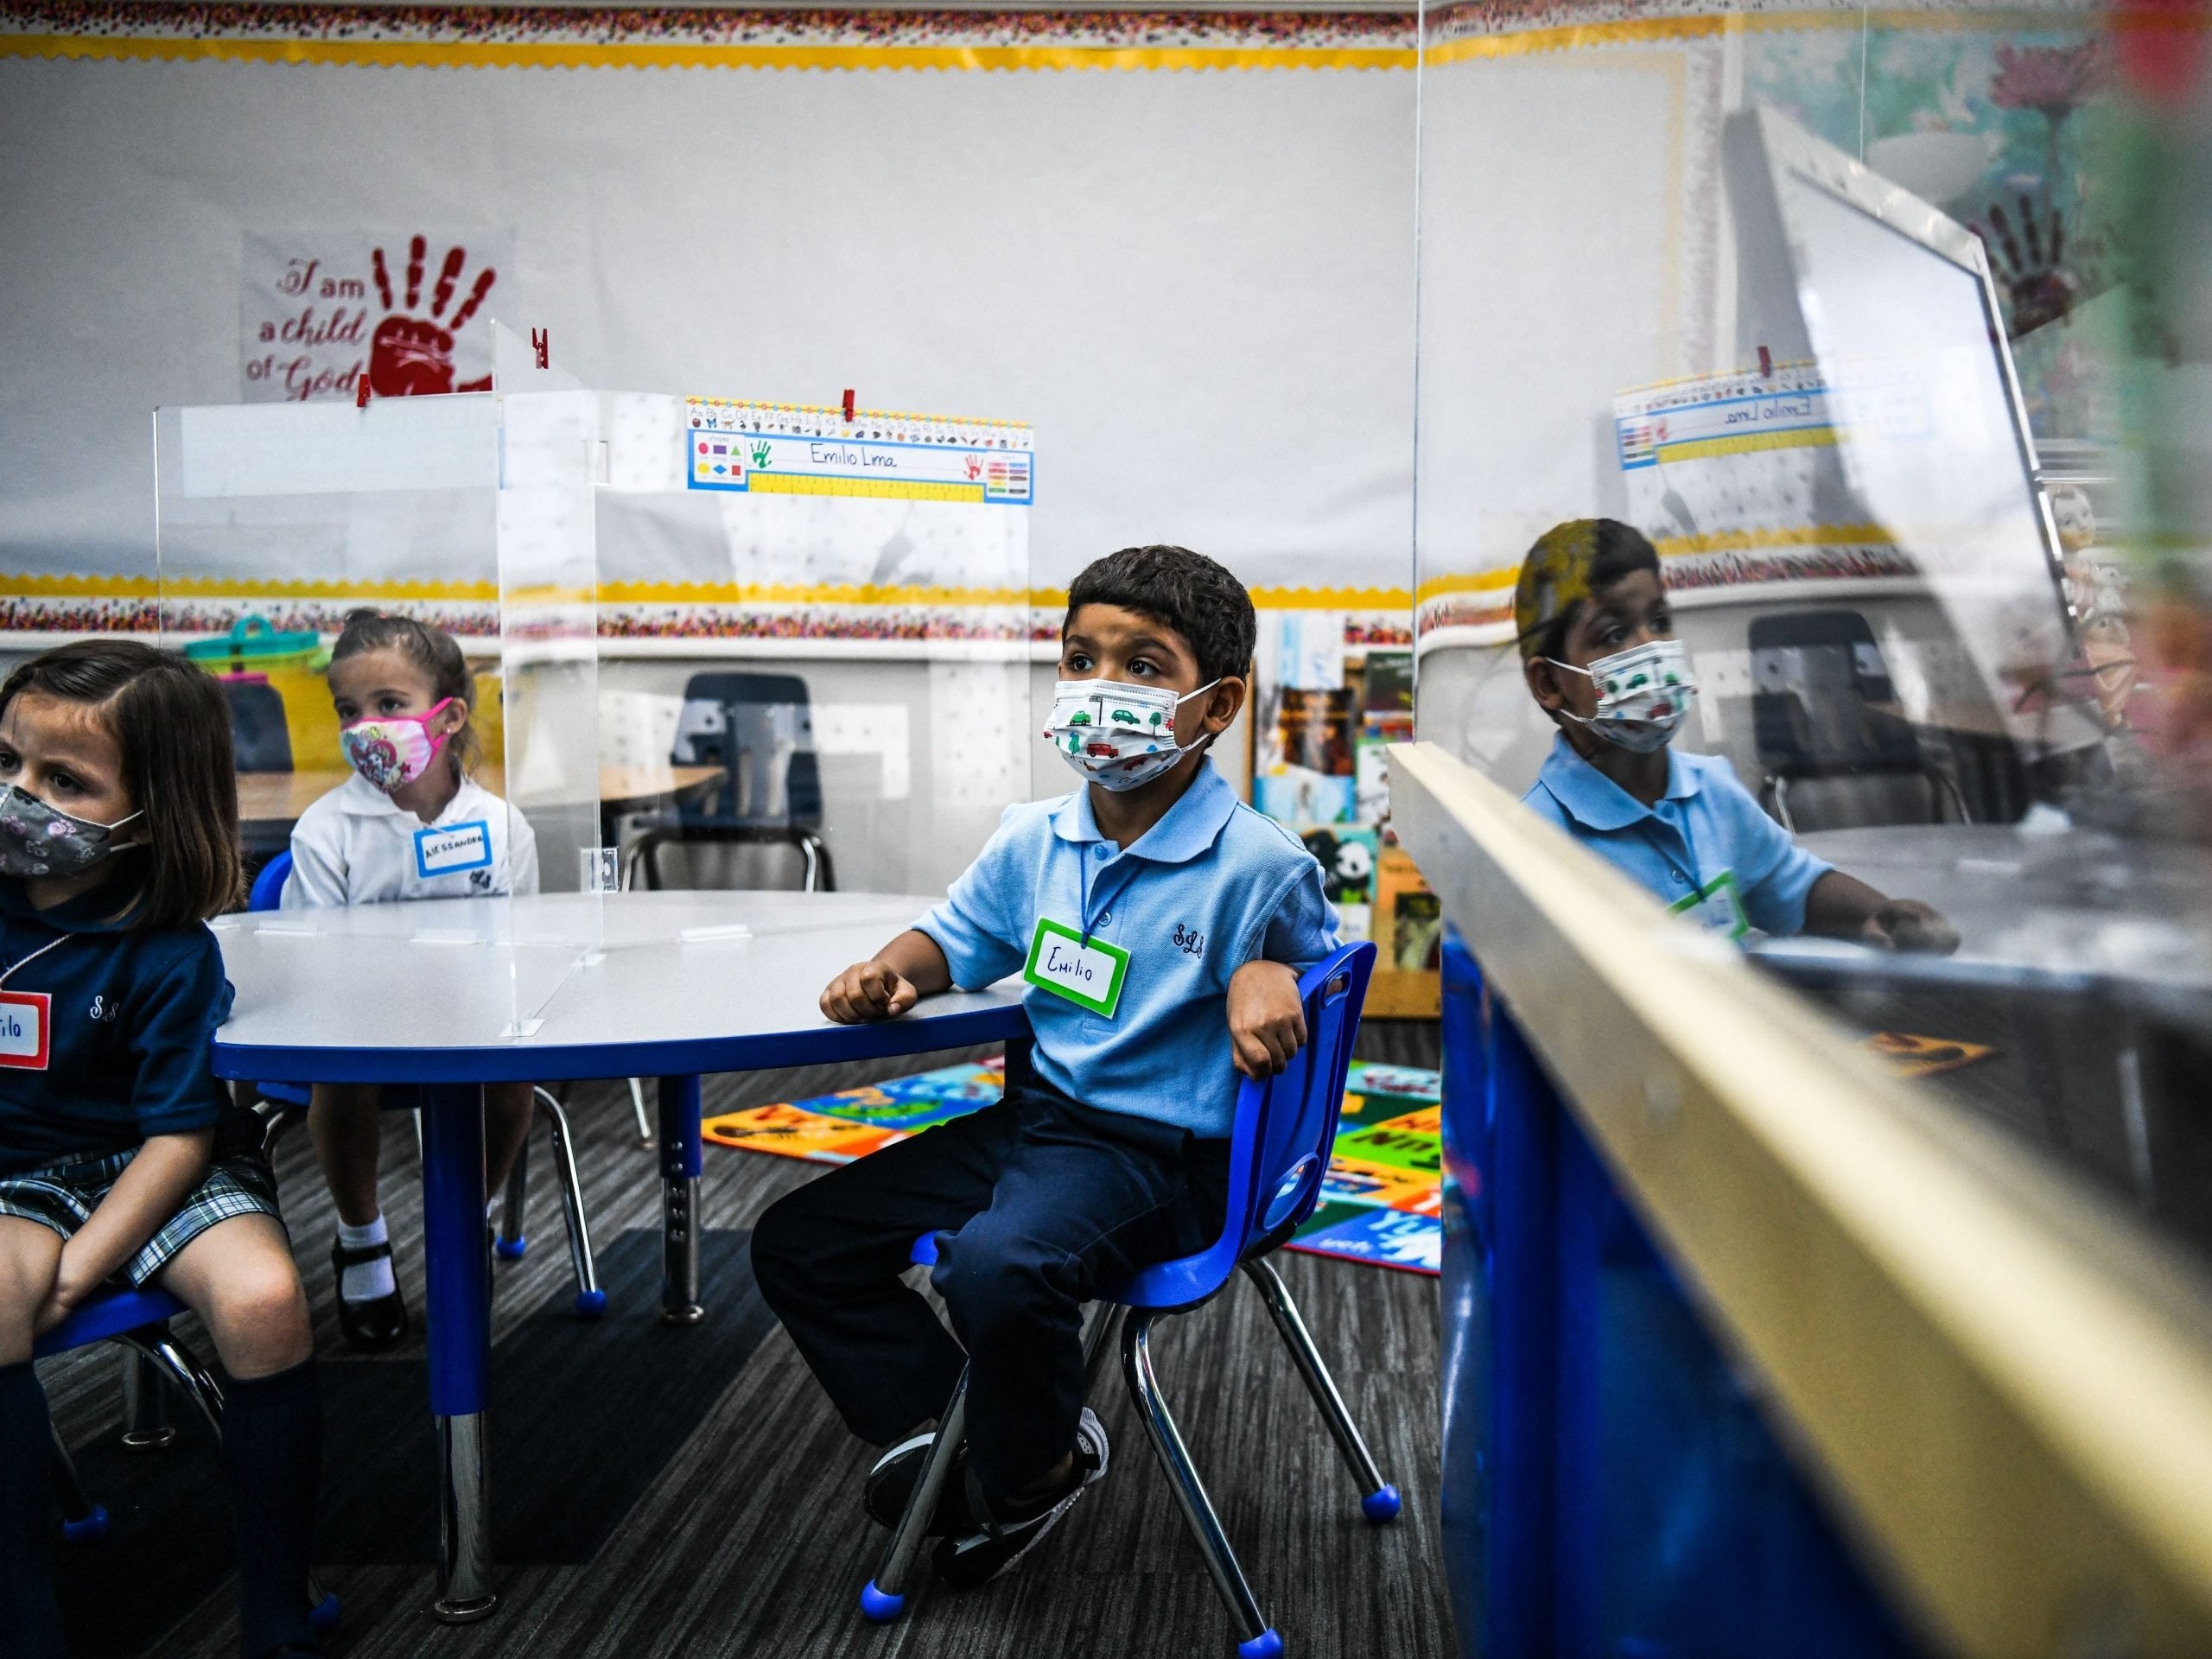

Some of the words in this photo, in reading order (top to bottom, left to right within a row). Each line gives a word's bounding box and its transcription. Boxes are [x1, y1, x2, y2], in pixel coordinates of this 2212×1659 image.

[276, 258, 319, 296] I
[319, 277, 365, 298] am
[259, 321, 275, 342] a
[281, 306, 367, 346] child
[246, 354, 275, 380] of
[276, 356, 364, 401] God
[810, 442, 857, 466] Emilio
[861, 446, 898, 468] Lima
